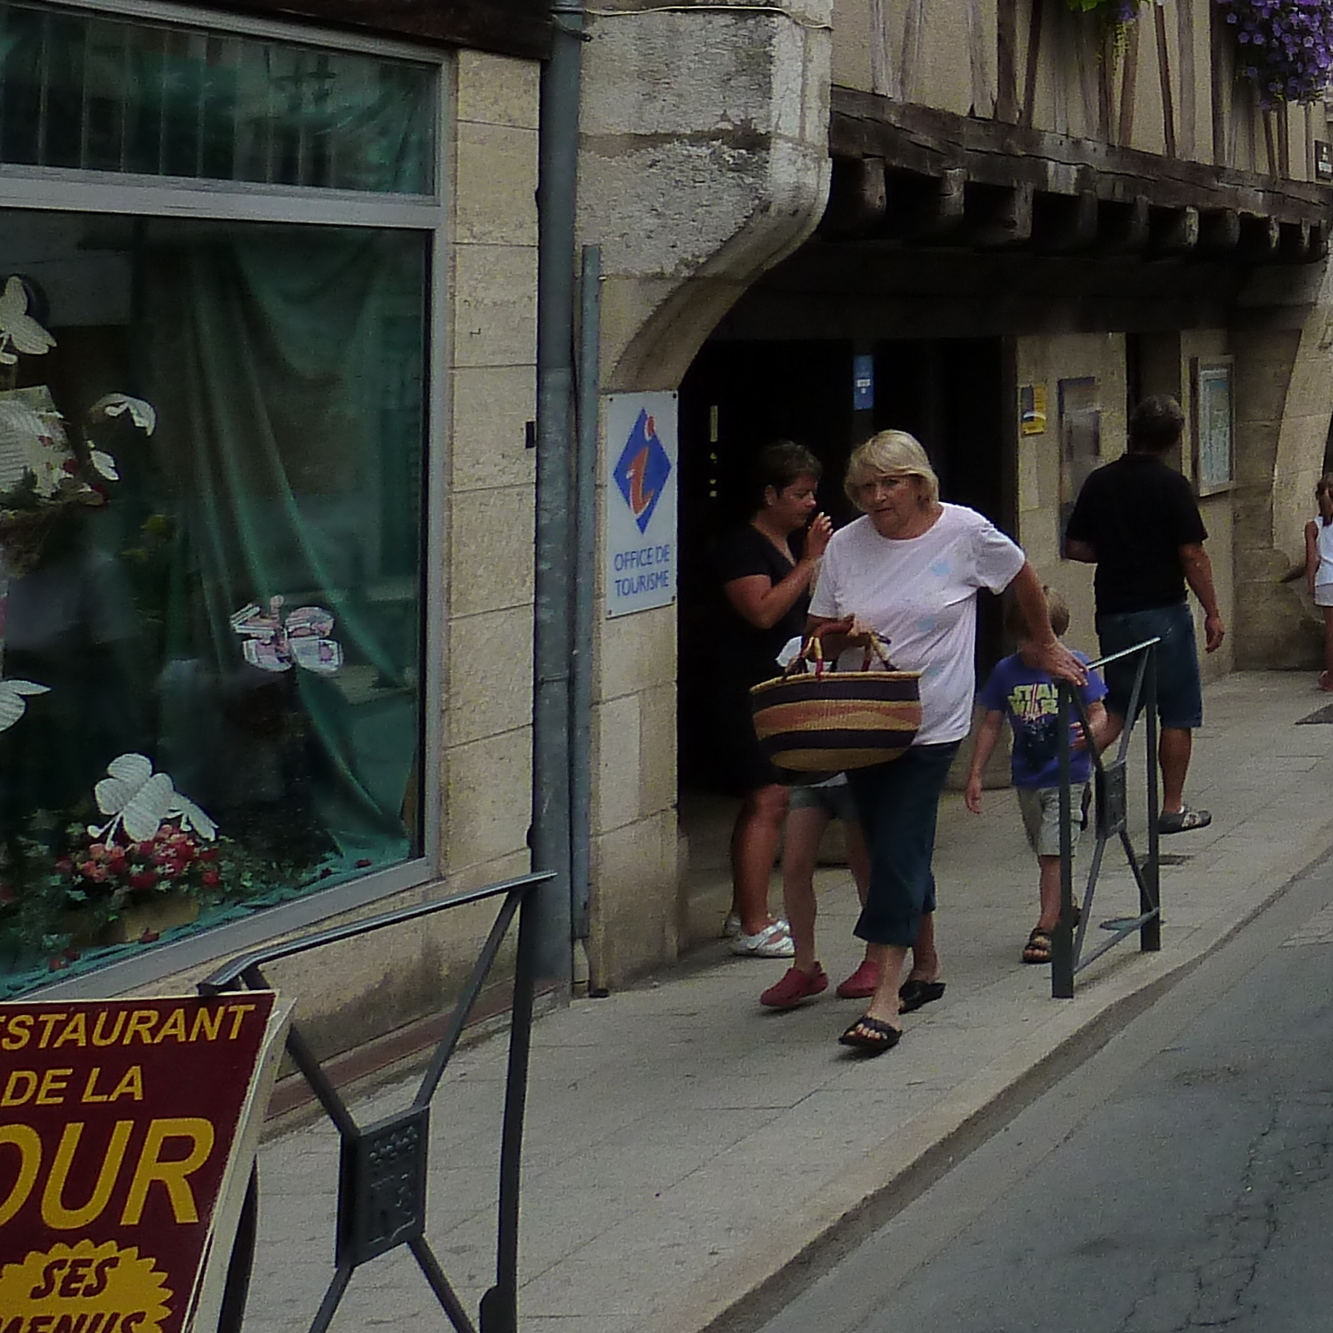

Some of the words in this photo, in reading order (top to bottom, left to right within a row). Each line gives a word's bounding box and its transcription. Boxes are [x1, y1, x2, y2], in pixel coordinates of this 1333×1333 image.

[614, 547, 654, 571] OFFICE
[656, 544, 670, 563] DE
[614, 570, 669, 597] TOURISME
[1010, 699, 1059, 716] WAR
[0, 1004, 255, 1051] STAURANT
[0, 1068, 73, 1107] DE
[81, 1065, 144, 1103] LA
[30, 1256, 120, 1300] SES
